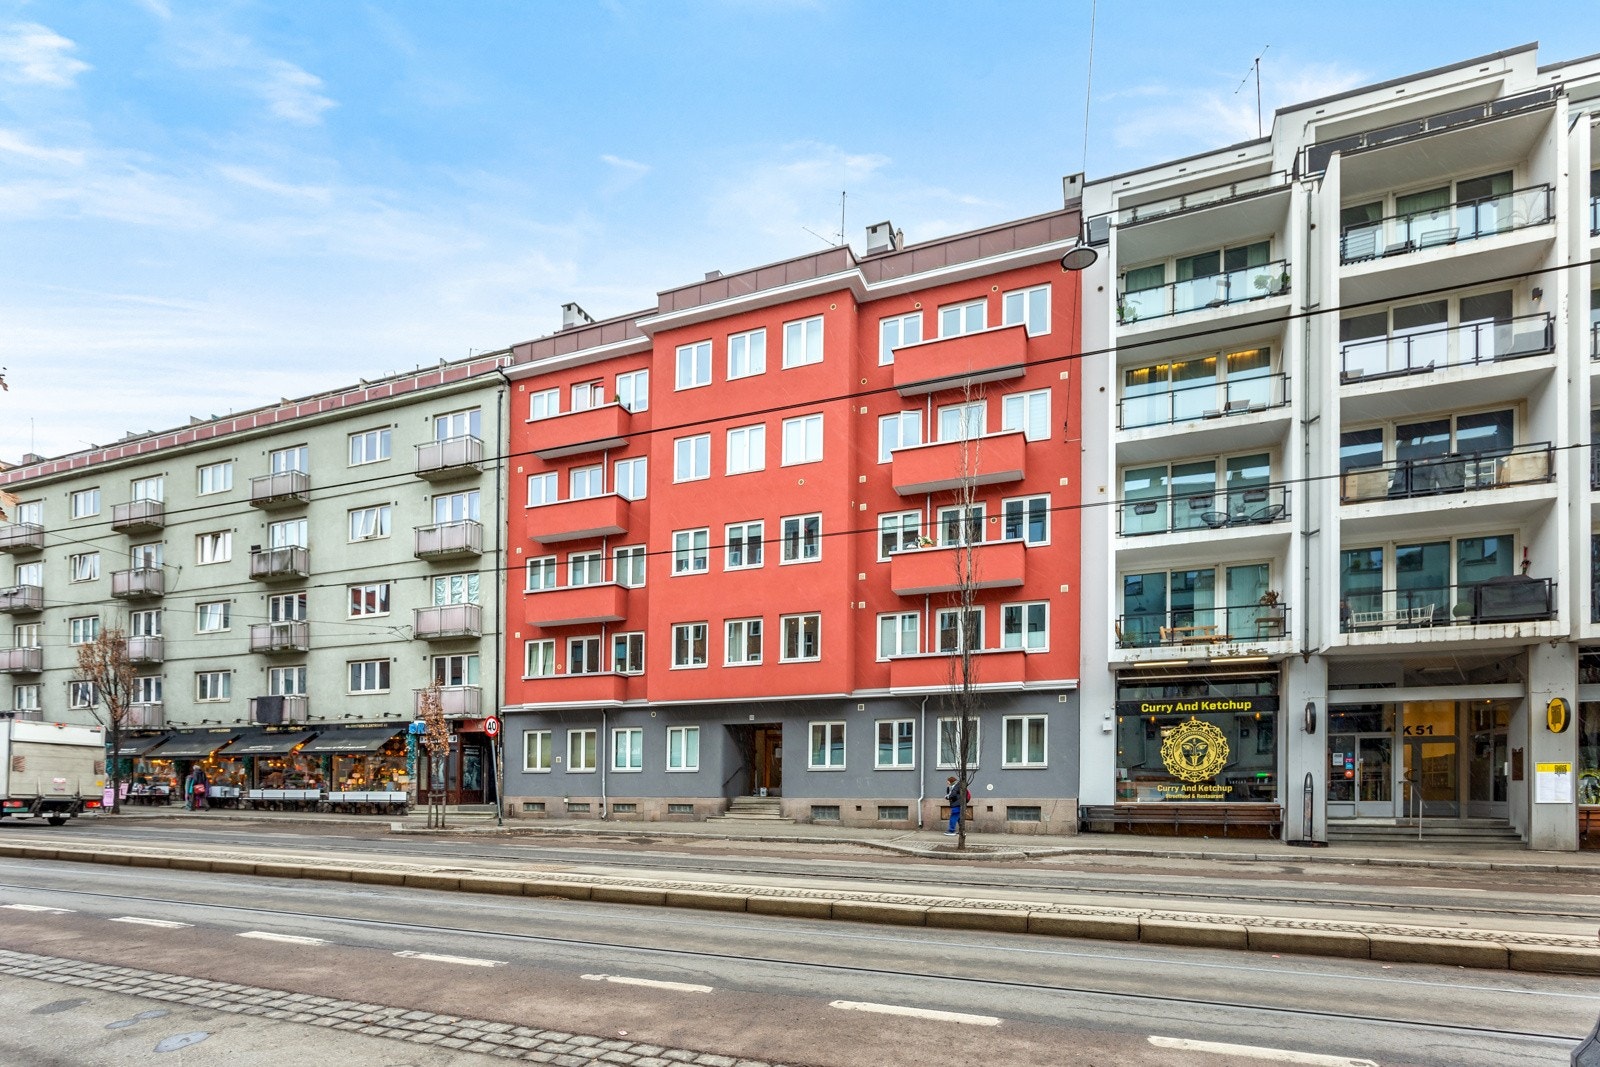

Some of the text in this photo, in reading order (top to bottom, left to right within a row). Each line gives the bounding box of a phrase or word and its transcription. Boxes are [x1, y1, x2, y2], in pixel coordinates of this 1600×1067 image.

[1141, 700, 1252, 714] Curry And Ketchup
[487, 721, 496, 731] 40
[1415, 724, 1433, 736] 51
[1157, 784, 1233, 793] Curry And Ketchup
